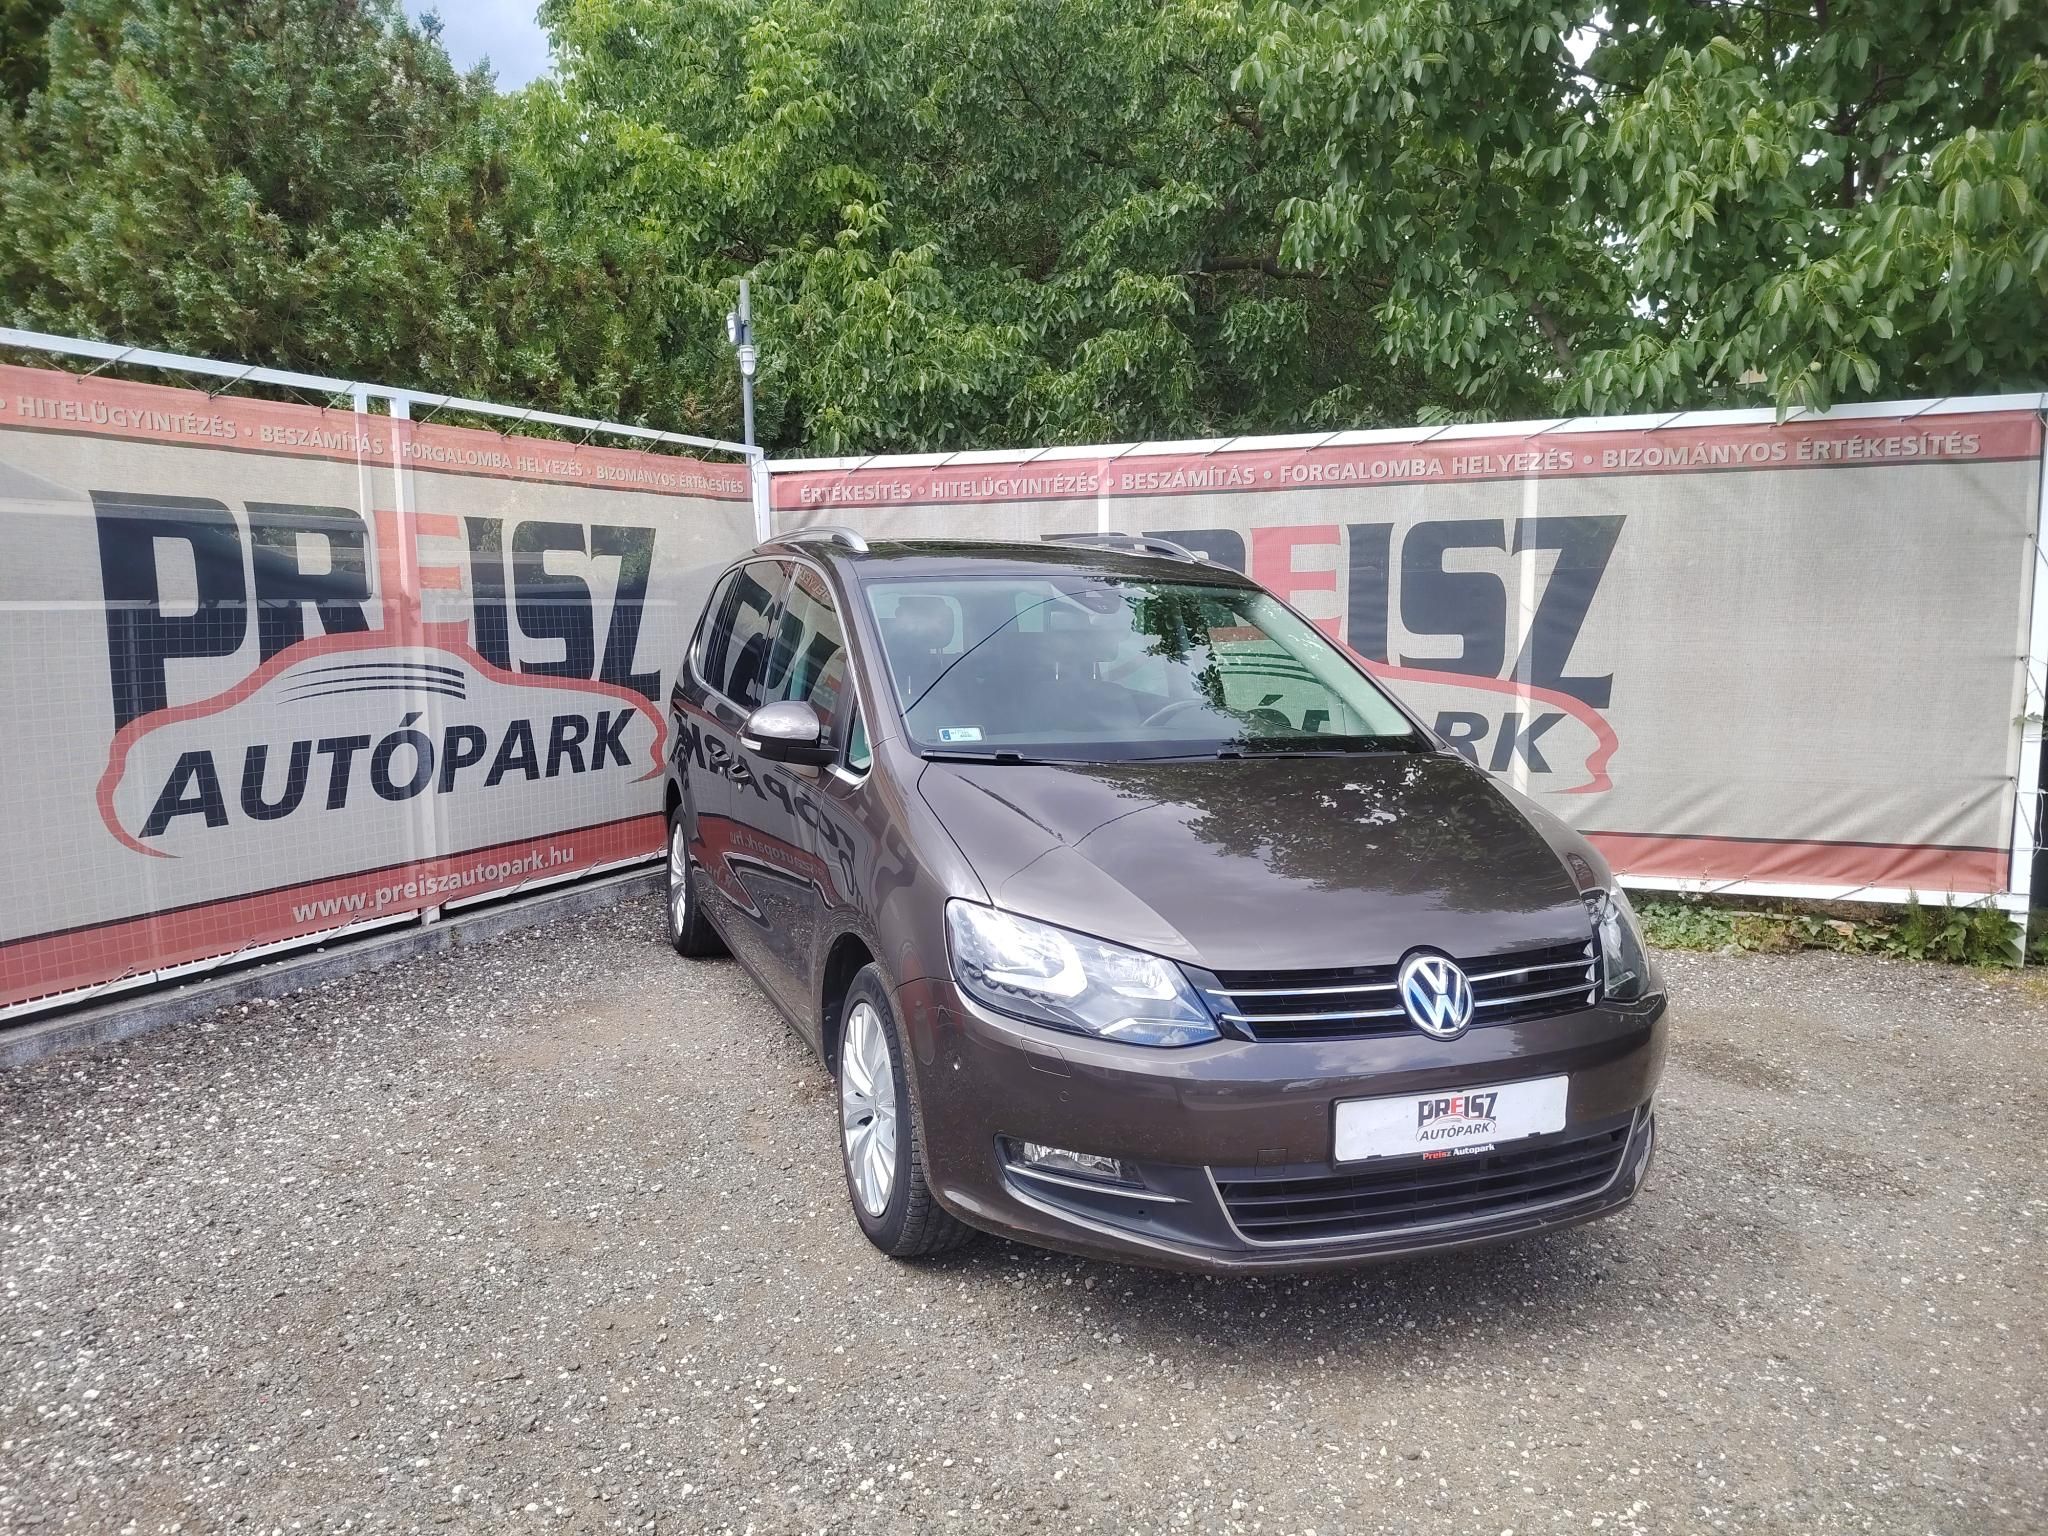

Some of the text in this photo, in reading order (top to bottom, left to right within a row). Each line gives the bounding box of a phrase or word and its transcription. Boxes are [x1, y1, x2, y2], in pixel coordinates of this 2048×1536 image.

[16, 395, 238, 440] HITELÜGYINTÉZÉS
[259, 424, 385, 455] BESZÁMÍTÁS
[401, 440, 514, 470] FORGALOMBA
[516, 455, 584, 478] HELYEZÉS
[595, 464, 677, 488] BIZOMÁNYOS
[799, 430, 1982, 504] ÉRTÉKESÍTÉS HITELÜGYINTÉZÉS BESZÁMÍTÁS FORGALOMBA HELYEZÉS BIZOMÁNYOS ÉRTÉKESÍTÉS
[88, 490, 661, 736] PREISZ
[137, 706, 637, 840] AUTÓPARK
[291, 845, 575, 924] www.preiszautopark.hu
[1418, 1091, 1499, 1128] PREISZ
[1419, 1121, 1491, 1142] AUTÓPARK
[1452, 1143, 1496, 1157] Autopark
